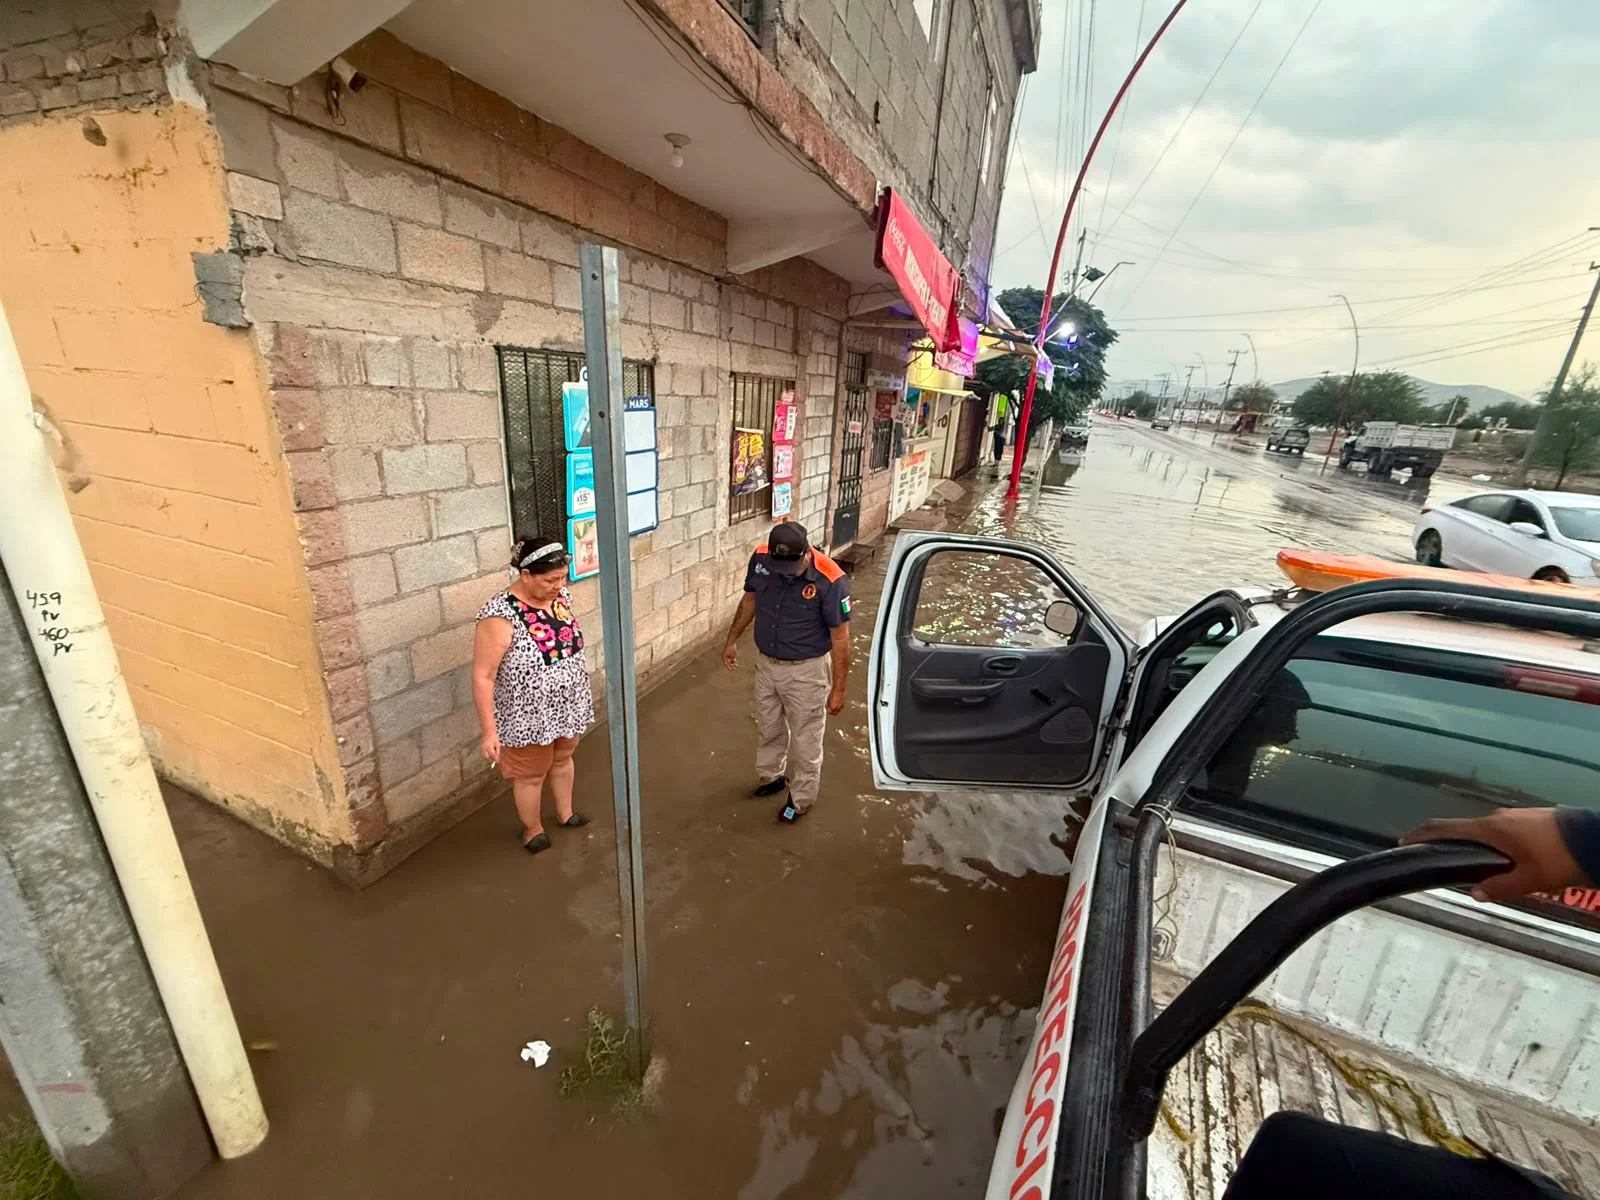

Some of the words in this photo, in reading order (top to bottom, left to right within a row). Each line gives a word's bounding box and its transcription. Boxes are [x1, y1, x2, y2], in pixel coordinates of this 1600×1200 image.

[628, 399, 649, 409] MARS
[26, 590, 61, 608] 459
[38, 627, 69, 641] 460
